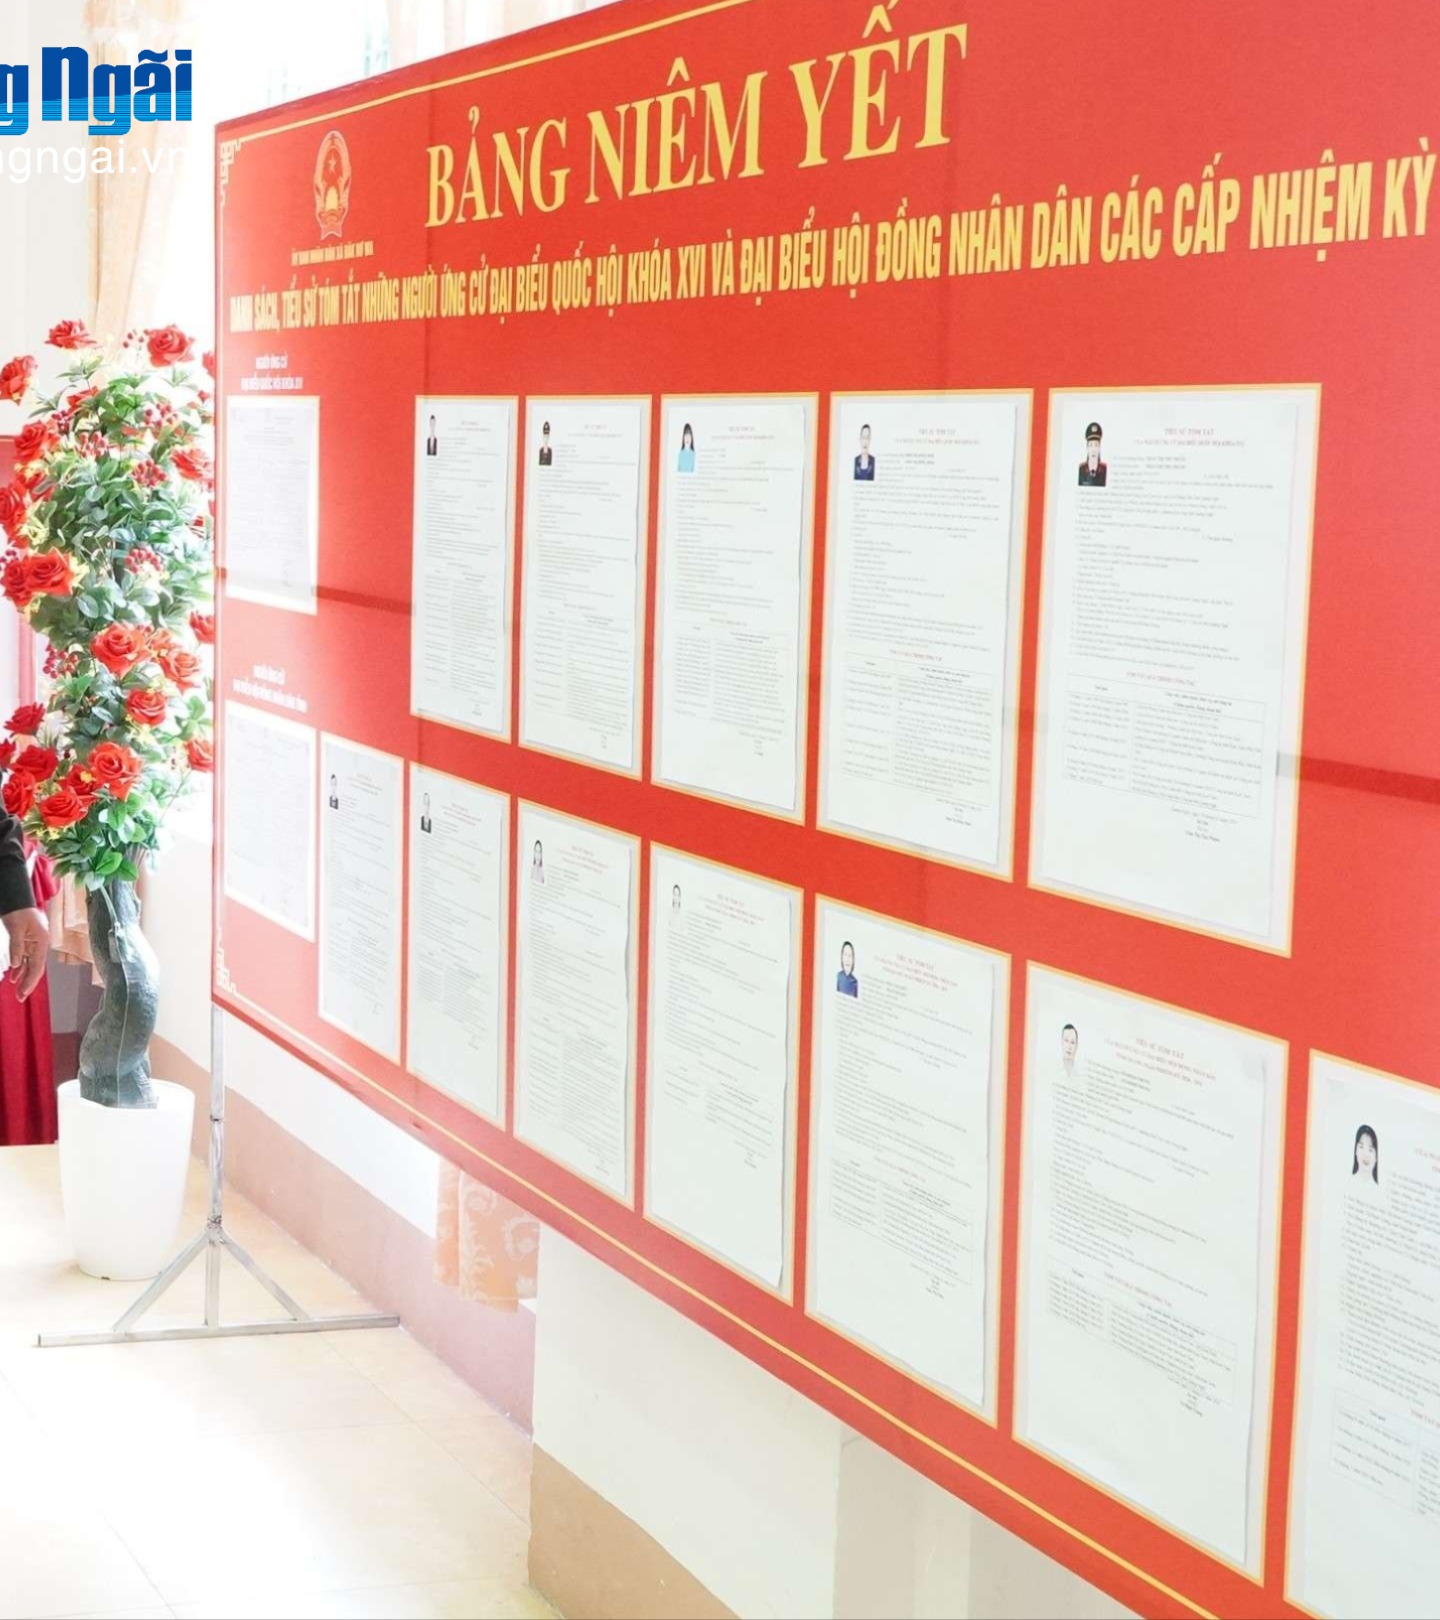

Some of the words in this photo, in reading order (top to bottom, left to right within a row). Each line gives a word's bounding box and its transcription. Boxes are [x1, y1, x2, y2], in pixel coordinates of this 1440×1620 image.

[425, 105, 571, 228] BẢNG
[585, 56, 768, 204] NIÊM
[788, 0, 967, 168] YẾT
[282, 273, 301, 328] TIỂU
[303, 275, 318, 328] SỬ
[319, 277, 339, 326] TÓM
[342, 267, 361, 324] TẮT
[362, 271, 399, 323] NHỮNG
[402, 263, 438, 319] NGƯỜI
[440, 263, 466, 318] ỨNG
[469, 254, 489, 316] CỬ
[489, 267, 512, 324] ĐẠI
[515, 243, 549, 312] BIỂU
[552, 240, 592, 315] QUỐC
[596, 243, 623, 317] HỘI
[627, 237, 672, 304] KHÓA
[676, 244, 707, 299] XVI
[711, 228, 735, 297] VÀ
[740, 235, 774, 306] ĐẠI
[778, 205, 827, 291] BIỂU
[832, 211, 870, 299] HỘI
[875, 197, 942, 283] ĐỒNG
[948, 193, 1024, 276] NHÂN
[1030, 184, 1093, 269] DÂN
[1100, 174, 1163, 263] CÁC
[1172, 152, 1241, 257] CẤP
[1249, 148, 1373, 262] NHIỆM
[1382, 136, 1437, 239] KỲ
